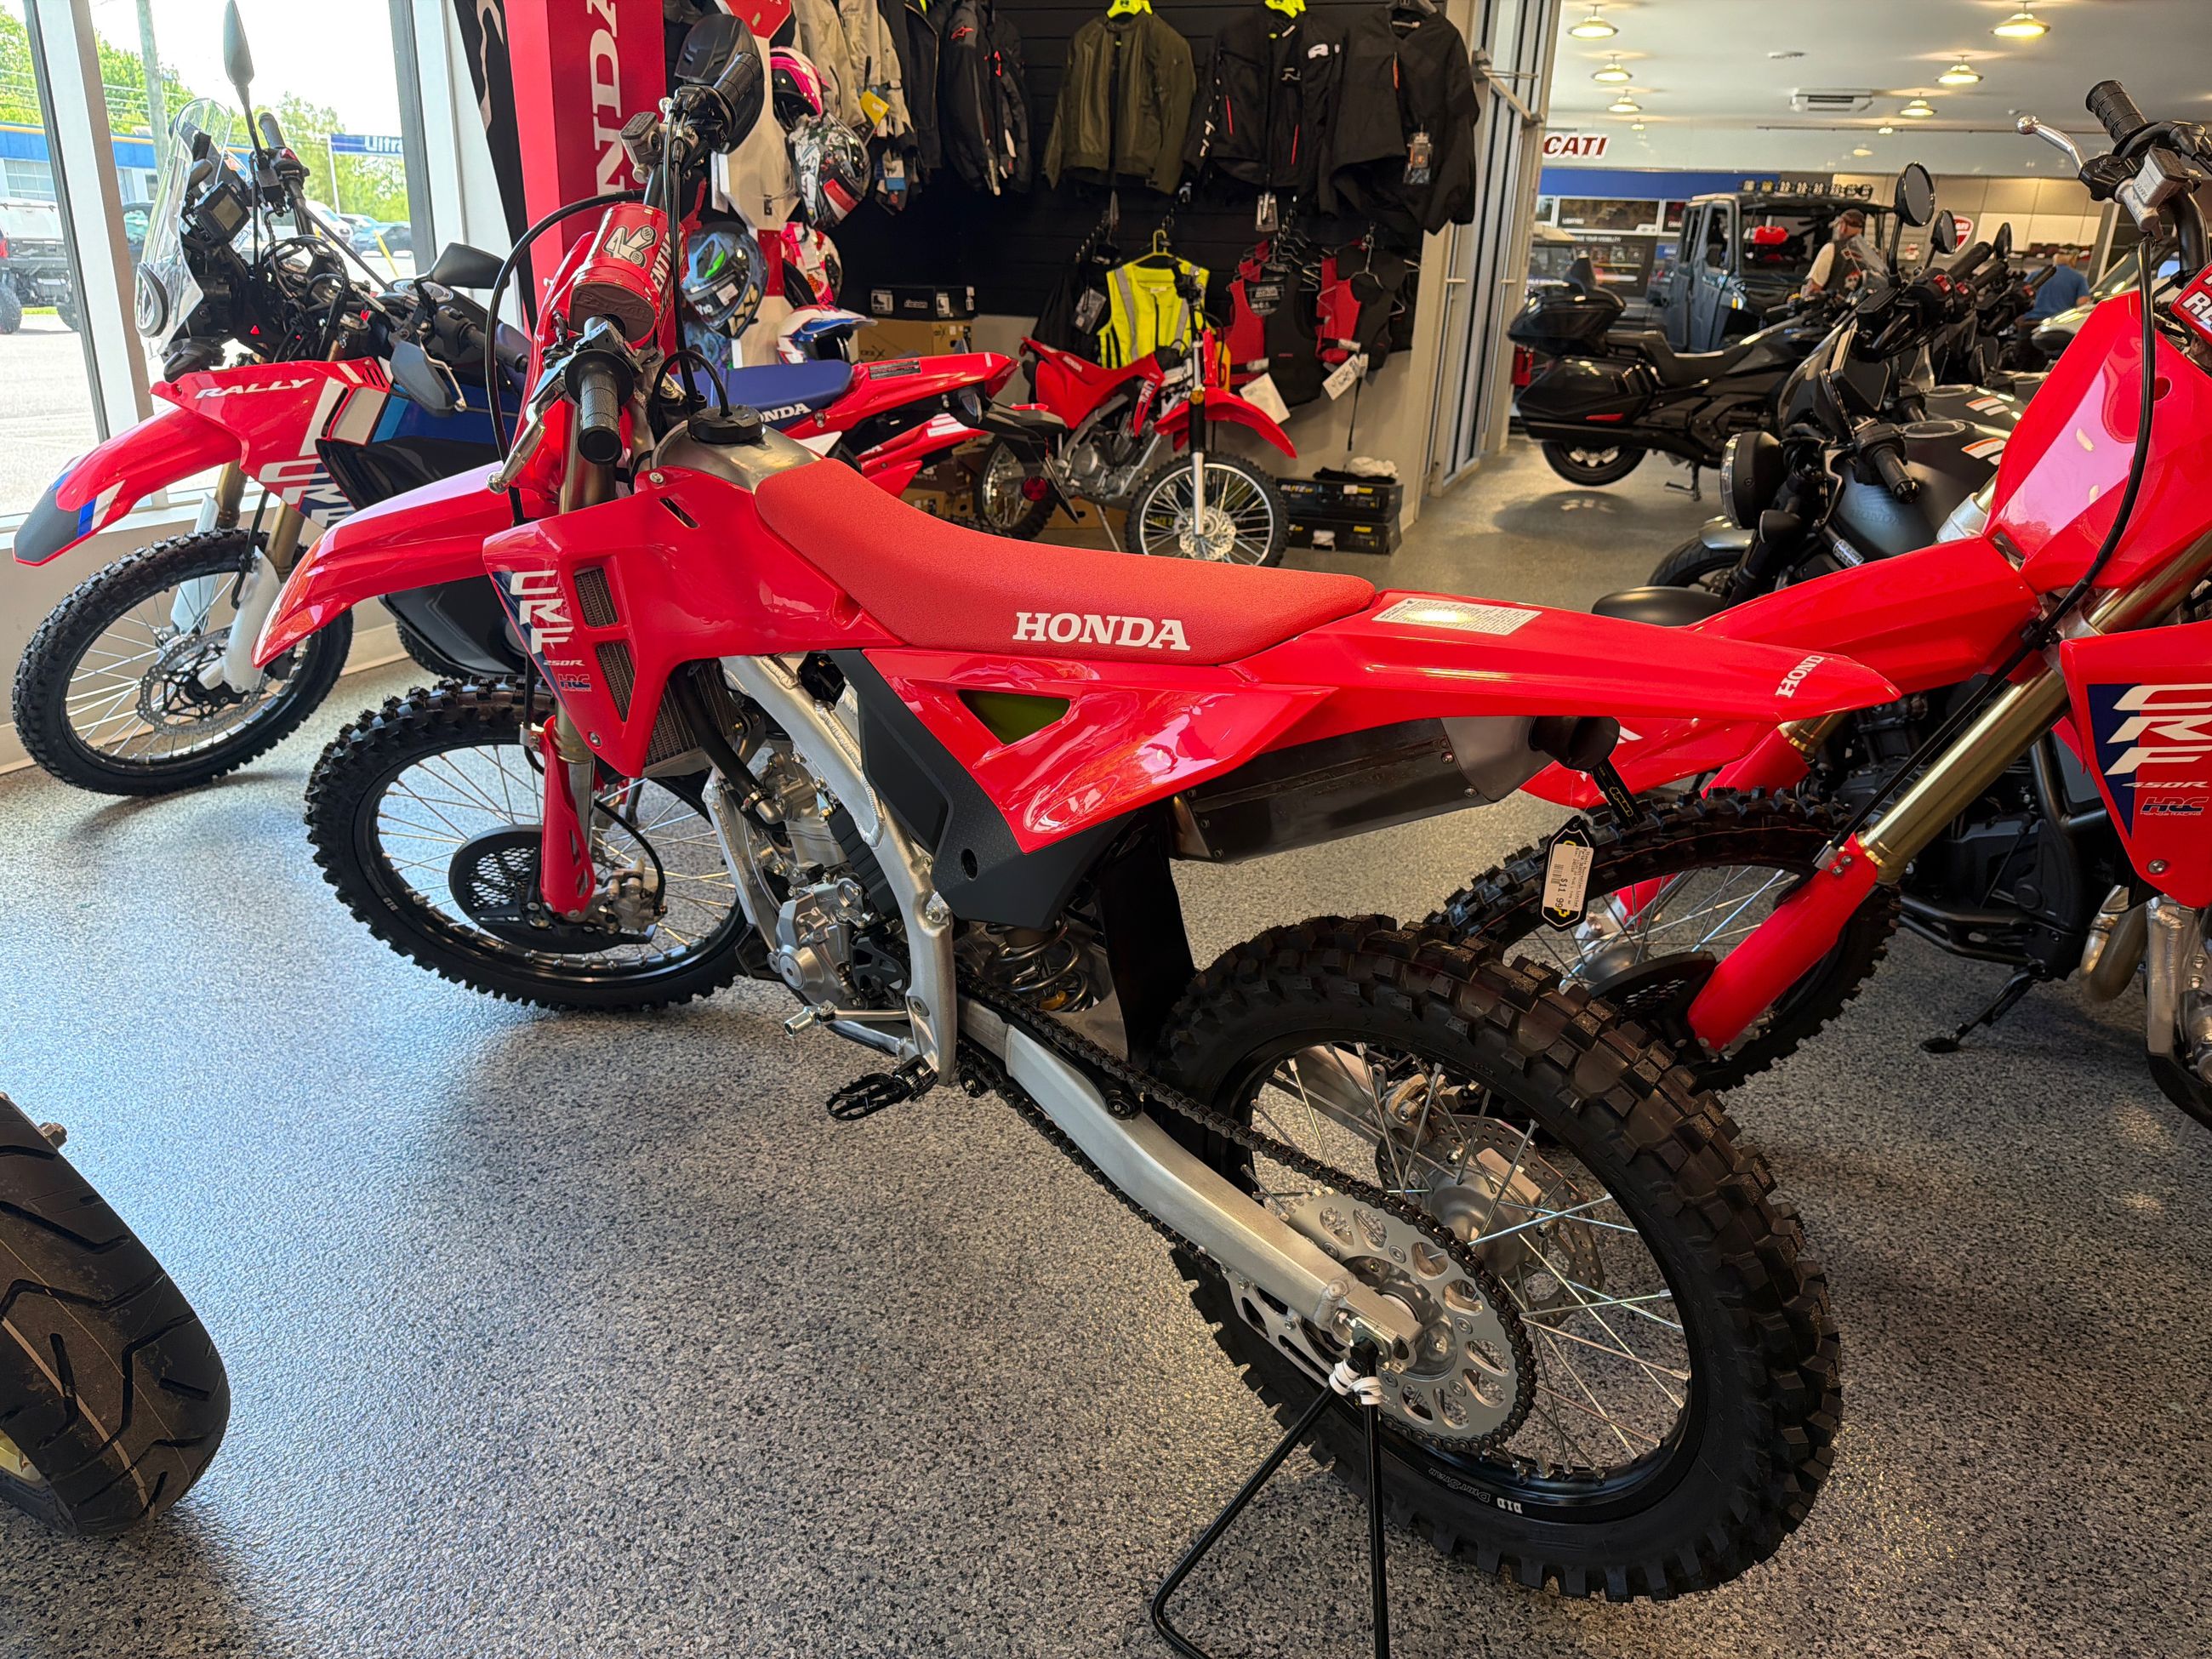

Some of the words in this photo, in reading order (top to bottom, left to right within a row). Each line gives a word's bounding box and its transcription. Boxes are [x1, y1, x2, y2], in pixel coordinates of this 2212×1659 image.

[195, 378, 315, 400] RALLY
[510, 569, 574, 655] CRF
[1012, 612, 1191, 651] HONDA
[1775, 654, 1825, 698] HOND
[2104, 683, 2212, 775] CRF
[2141, 796, 2209, 812] HRC
